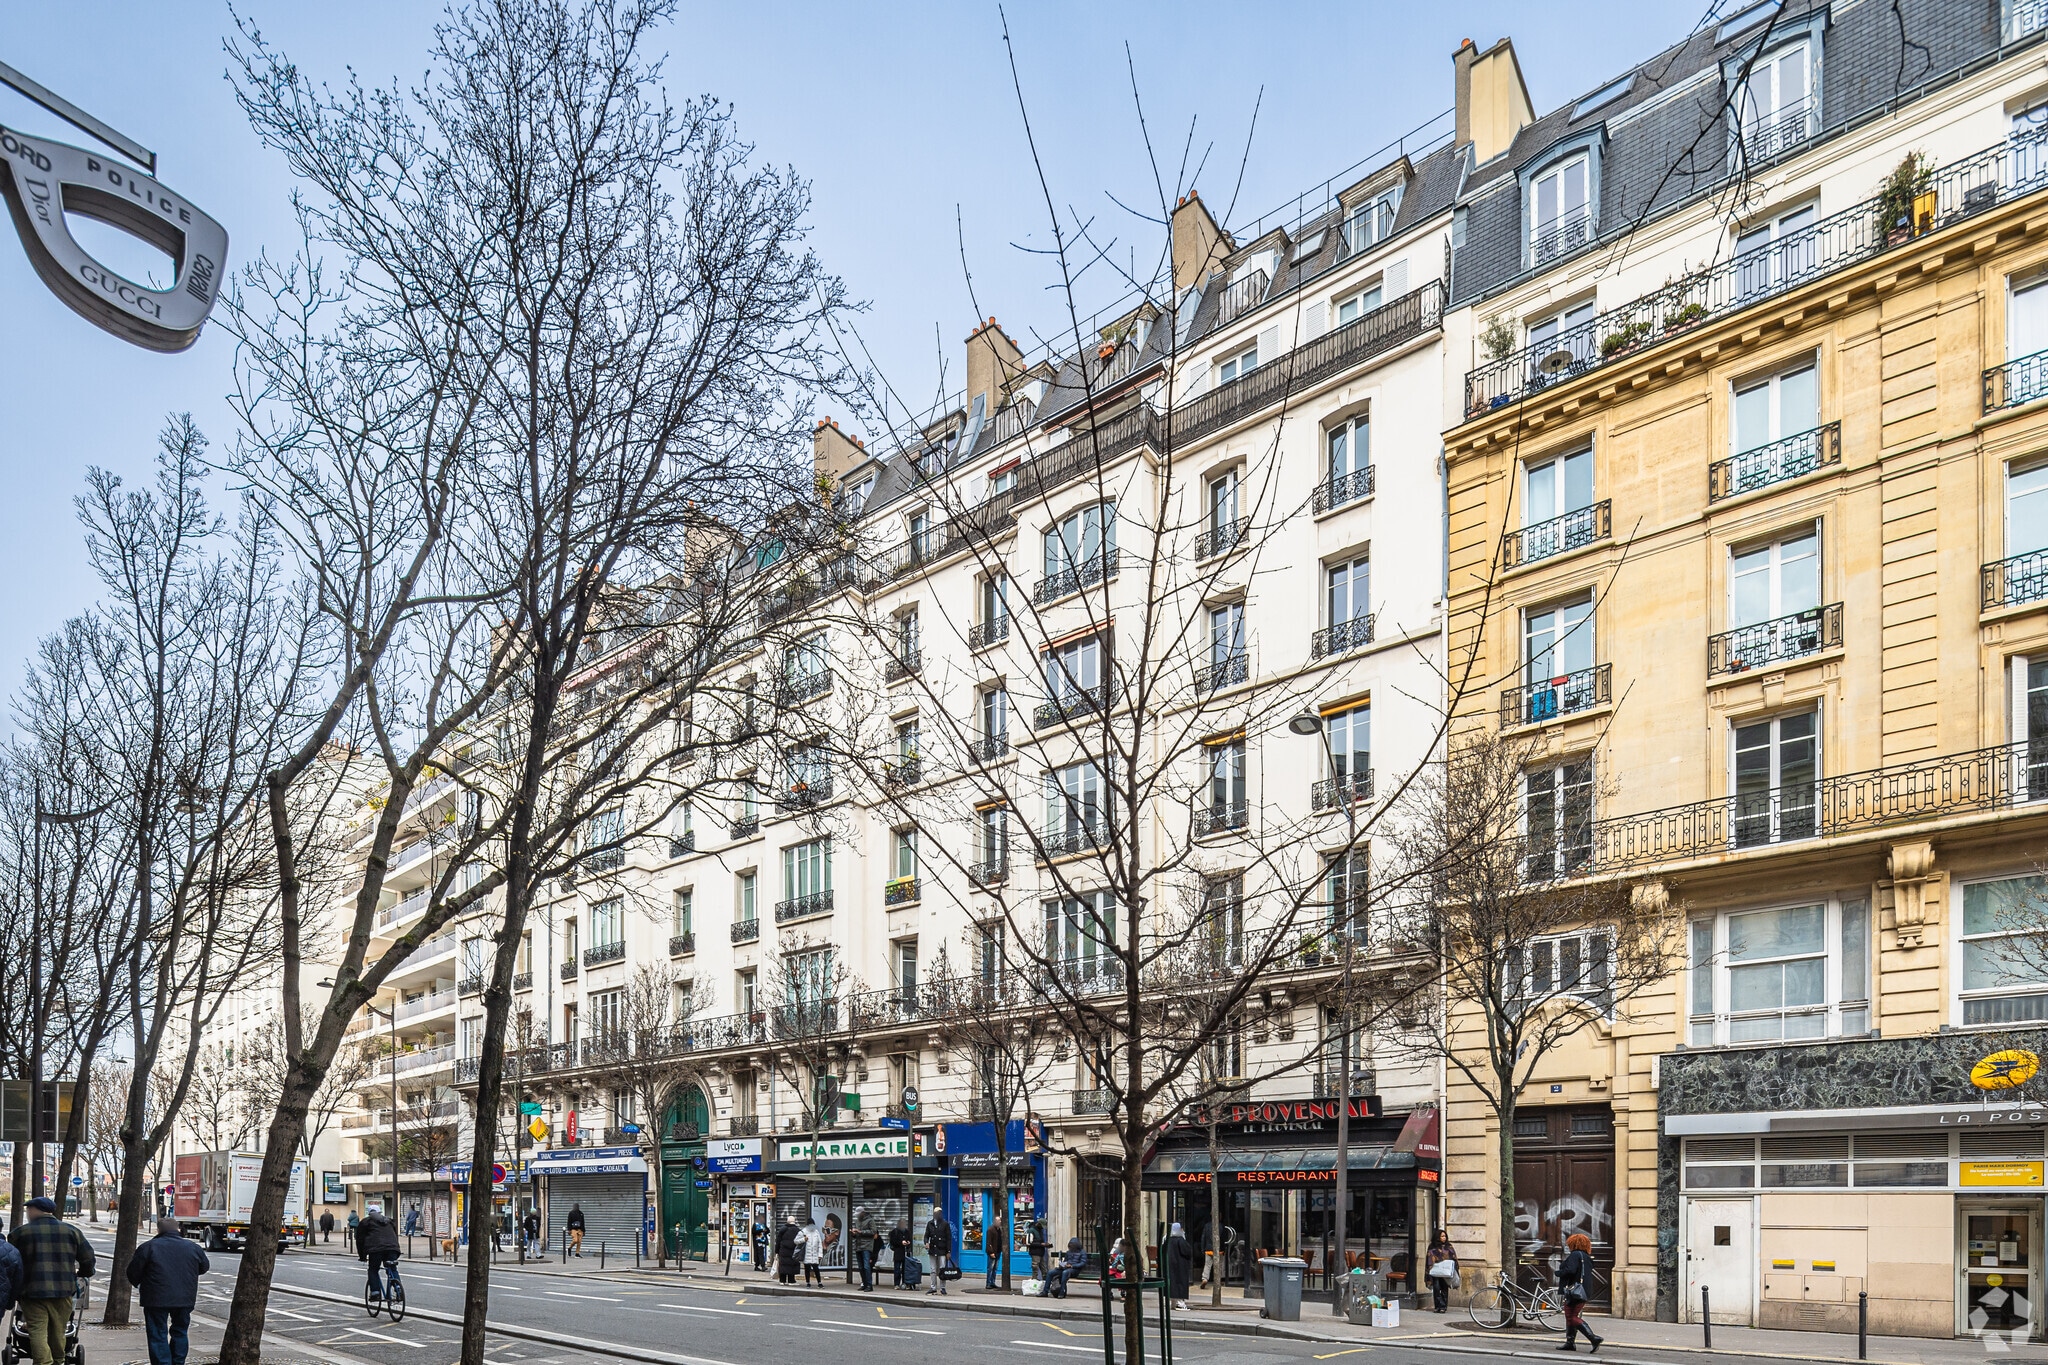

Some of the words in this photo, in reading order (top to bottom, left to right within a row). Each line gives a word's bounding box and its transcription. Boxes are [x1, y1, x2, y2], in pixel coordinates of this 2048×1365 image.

[0, 129, 51, 173] ORD
[87, 157, 191, 225] POLICE
[25, 176, 52, 227] Dior
[80, 264, 163, 320] GUCCI
[905, 1091, 917, 1101] BUS
[1940, 1115, 1970, 1124] LA
[617, 1148, 634, 1156] PRESSE
[723, 1142, 740, 1152] Lyca
[790, 1141, 908, 1158] PHARMACIE
[725, 1157, 753, 1165] MULTIMEDIA
[602, 1164, 625, 1172] CADEAUX
[1237, 1170, 1338, 1182] RESTAURANT
[761, 1184, 774, 1194] Ria
[813, 1196, 846, 1209] LOEWE
